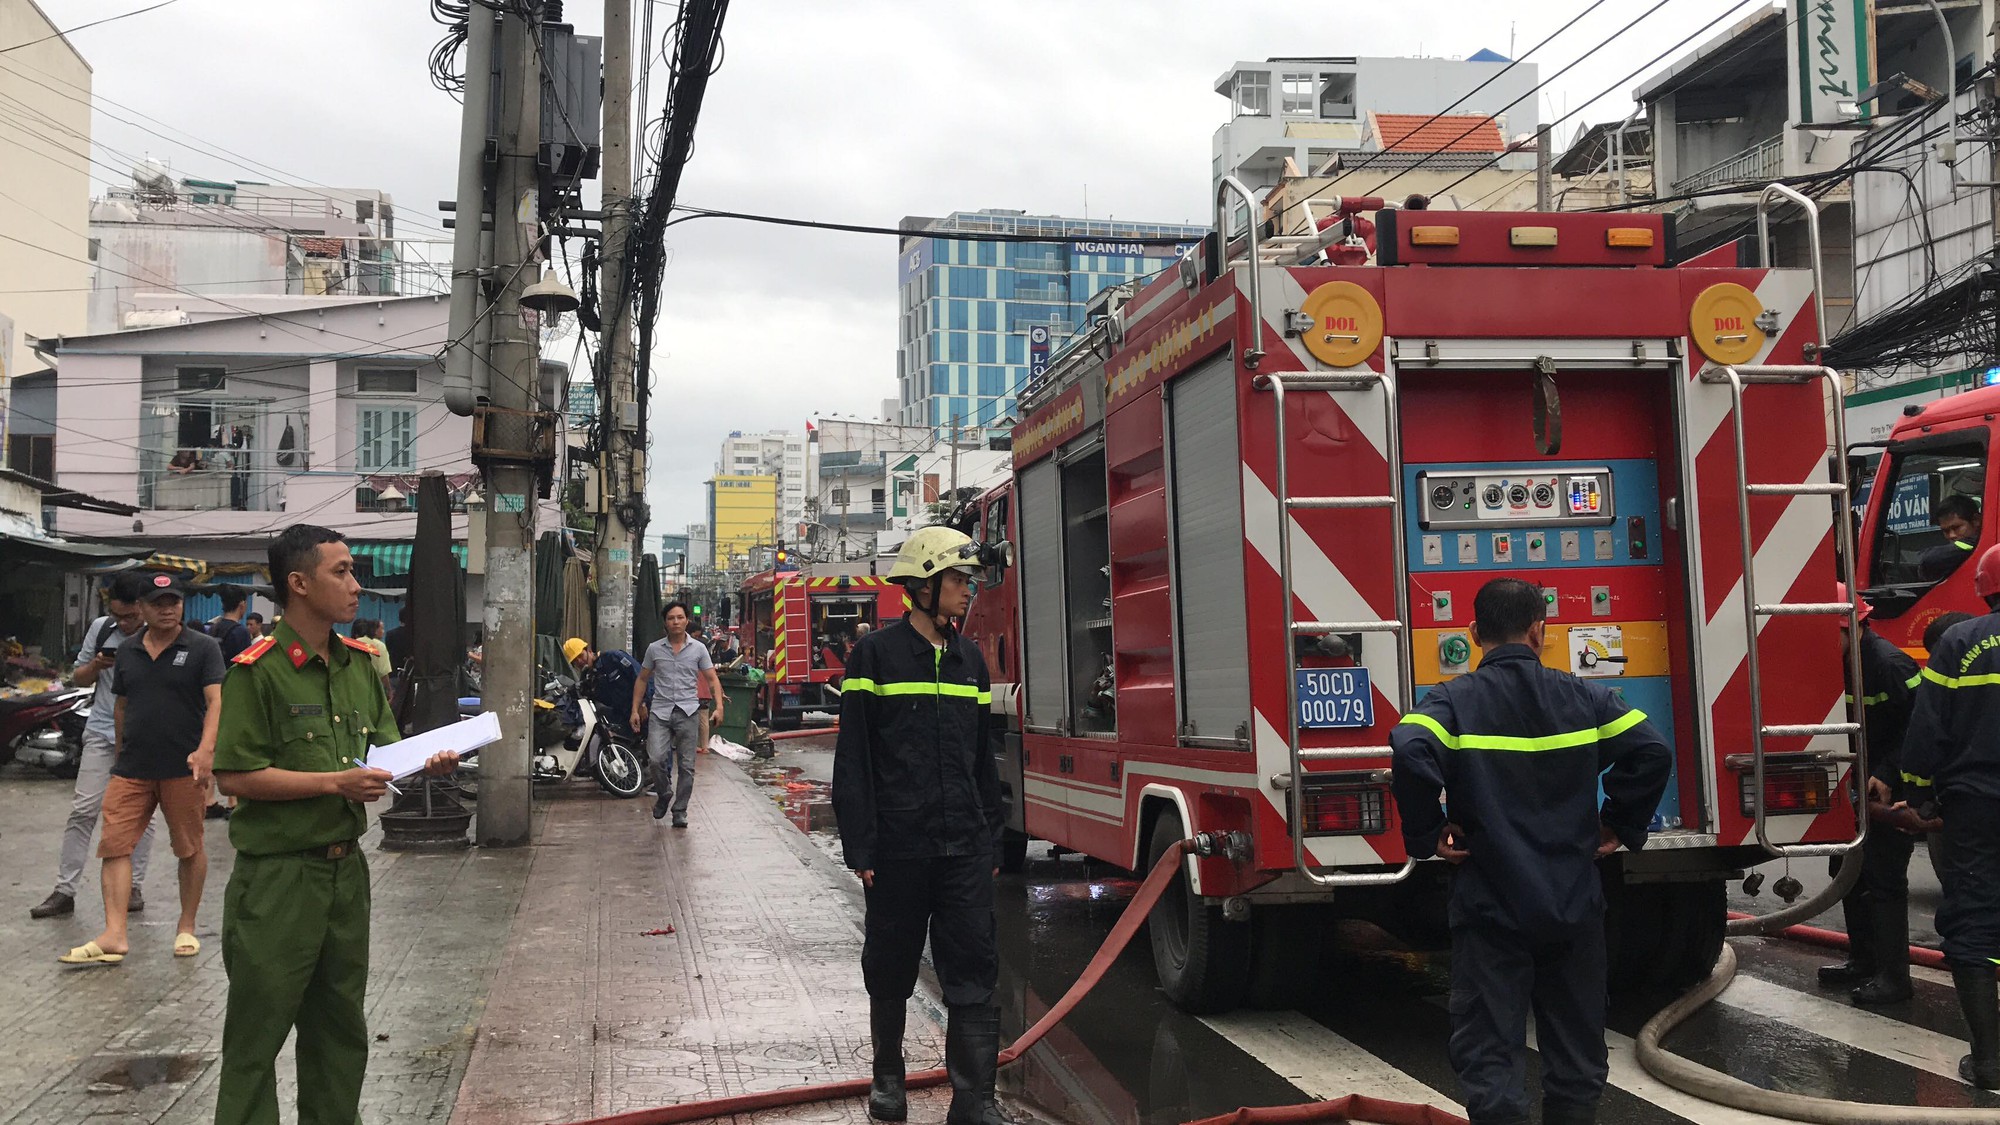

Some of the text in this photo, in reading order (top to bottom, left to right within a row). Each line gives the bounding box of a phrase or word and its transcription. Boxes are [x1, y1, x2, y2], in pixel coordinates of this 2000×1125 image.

[1325, 316, 1358, 331] DOL
[1714, 317, 1744, 332] DOL
[1150, 318, 1192, 374] QUẬN
[1197, 302, 1214, 343] 11
[1887, 494, 1901, 520] HỐ
[1904, 494, 1930, 517] VĂN
[1306, 672, 1354, 696] 50CD
[1301, 699, 1364, 722] 000.79
